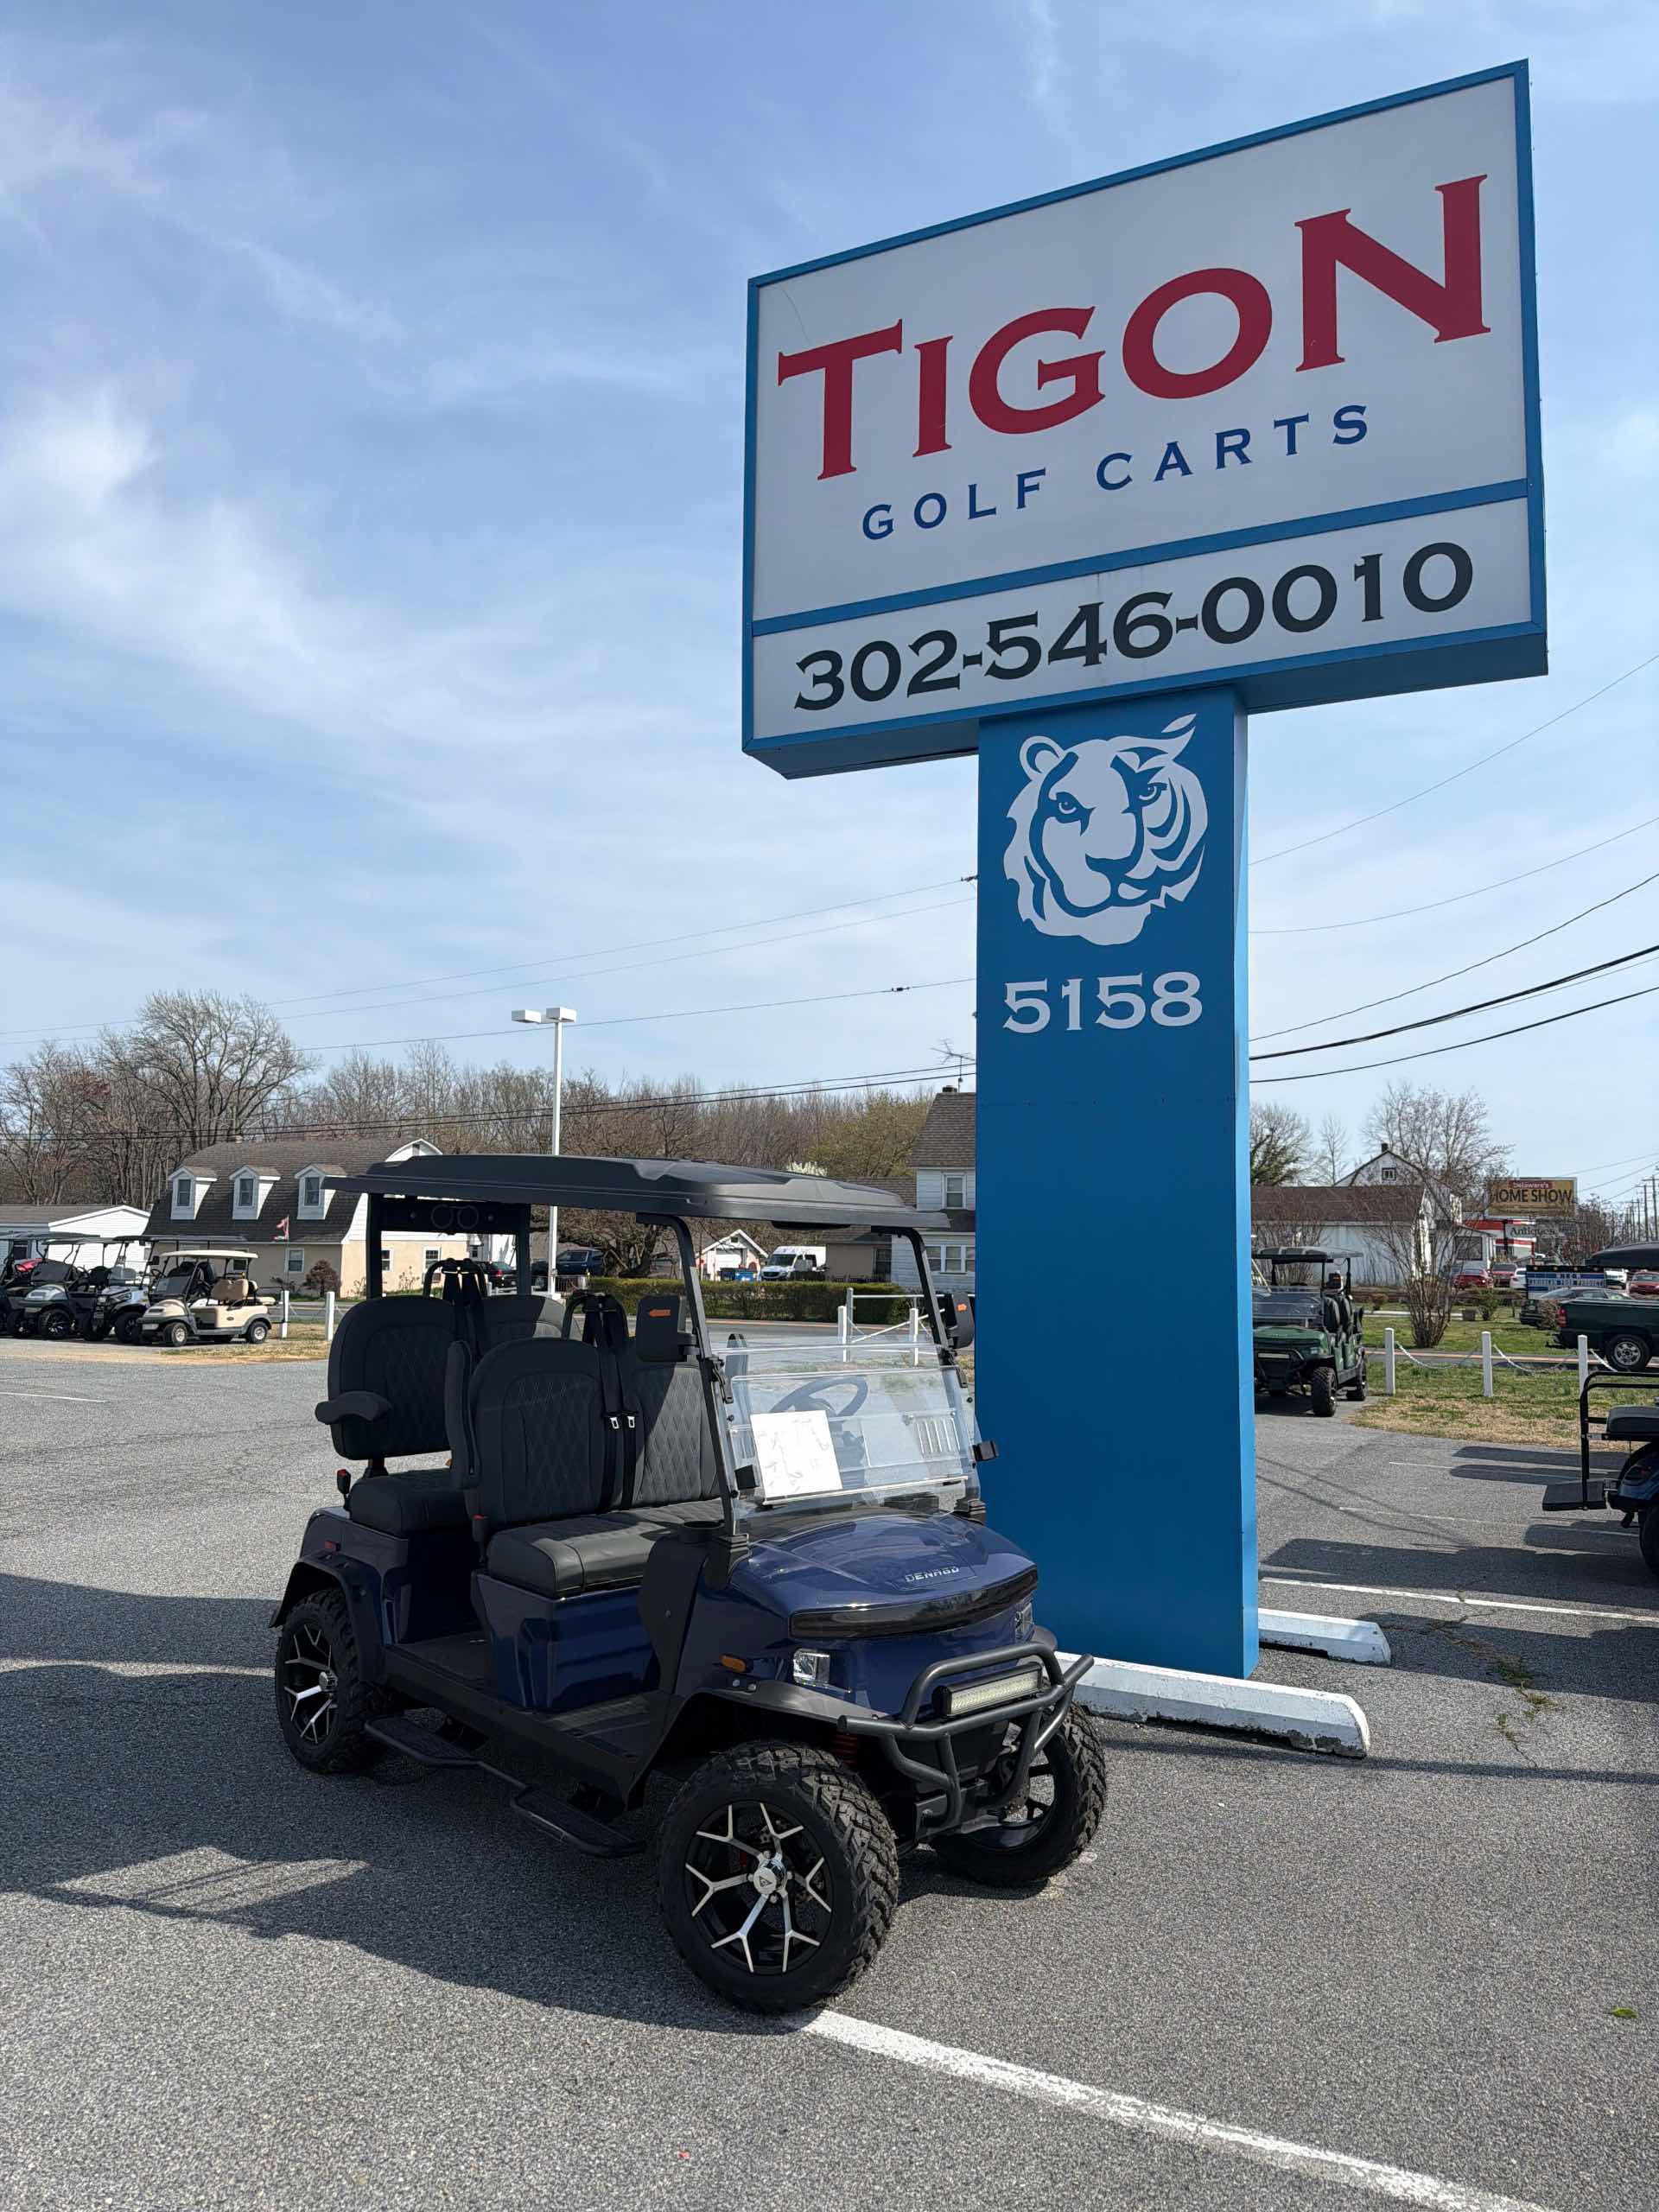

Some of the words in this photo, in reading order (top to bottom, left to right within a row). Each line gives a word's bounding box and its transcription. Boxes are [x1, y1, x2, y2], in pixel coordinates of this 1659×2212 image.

[777, 174, 1491, 481] TIGON
[862, 467, 1047, 541] GOLF
[1096, 404, 1368, 492] CARTS
[793, 542, 1474, 712] 302-546-0010
[1002, 971, 1204, 1033] 5158
[1490, 1189, 1529, 1203] HOME
[1530, 1189, 1573, 1203] SHOW
